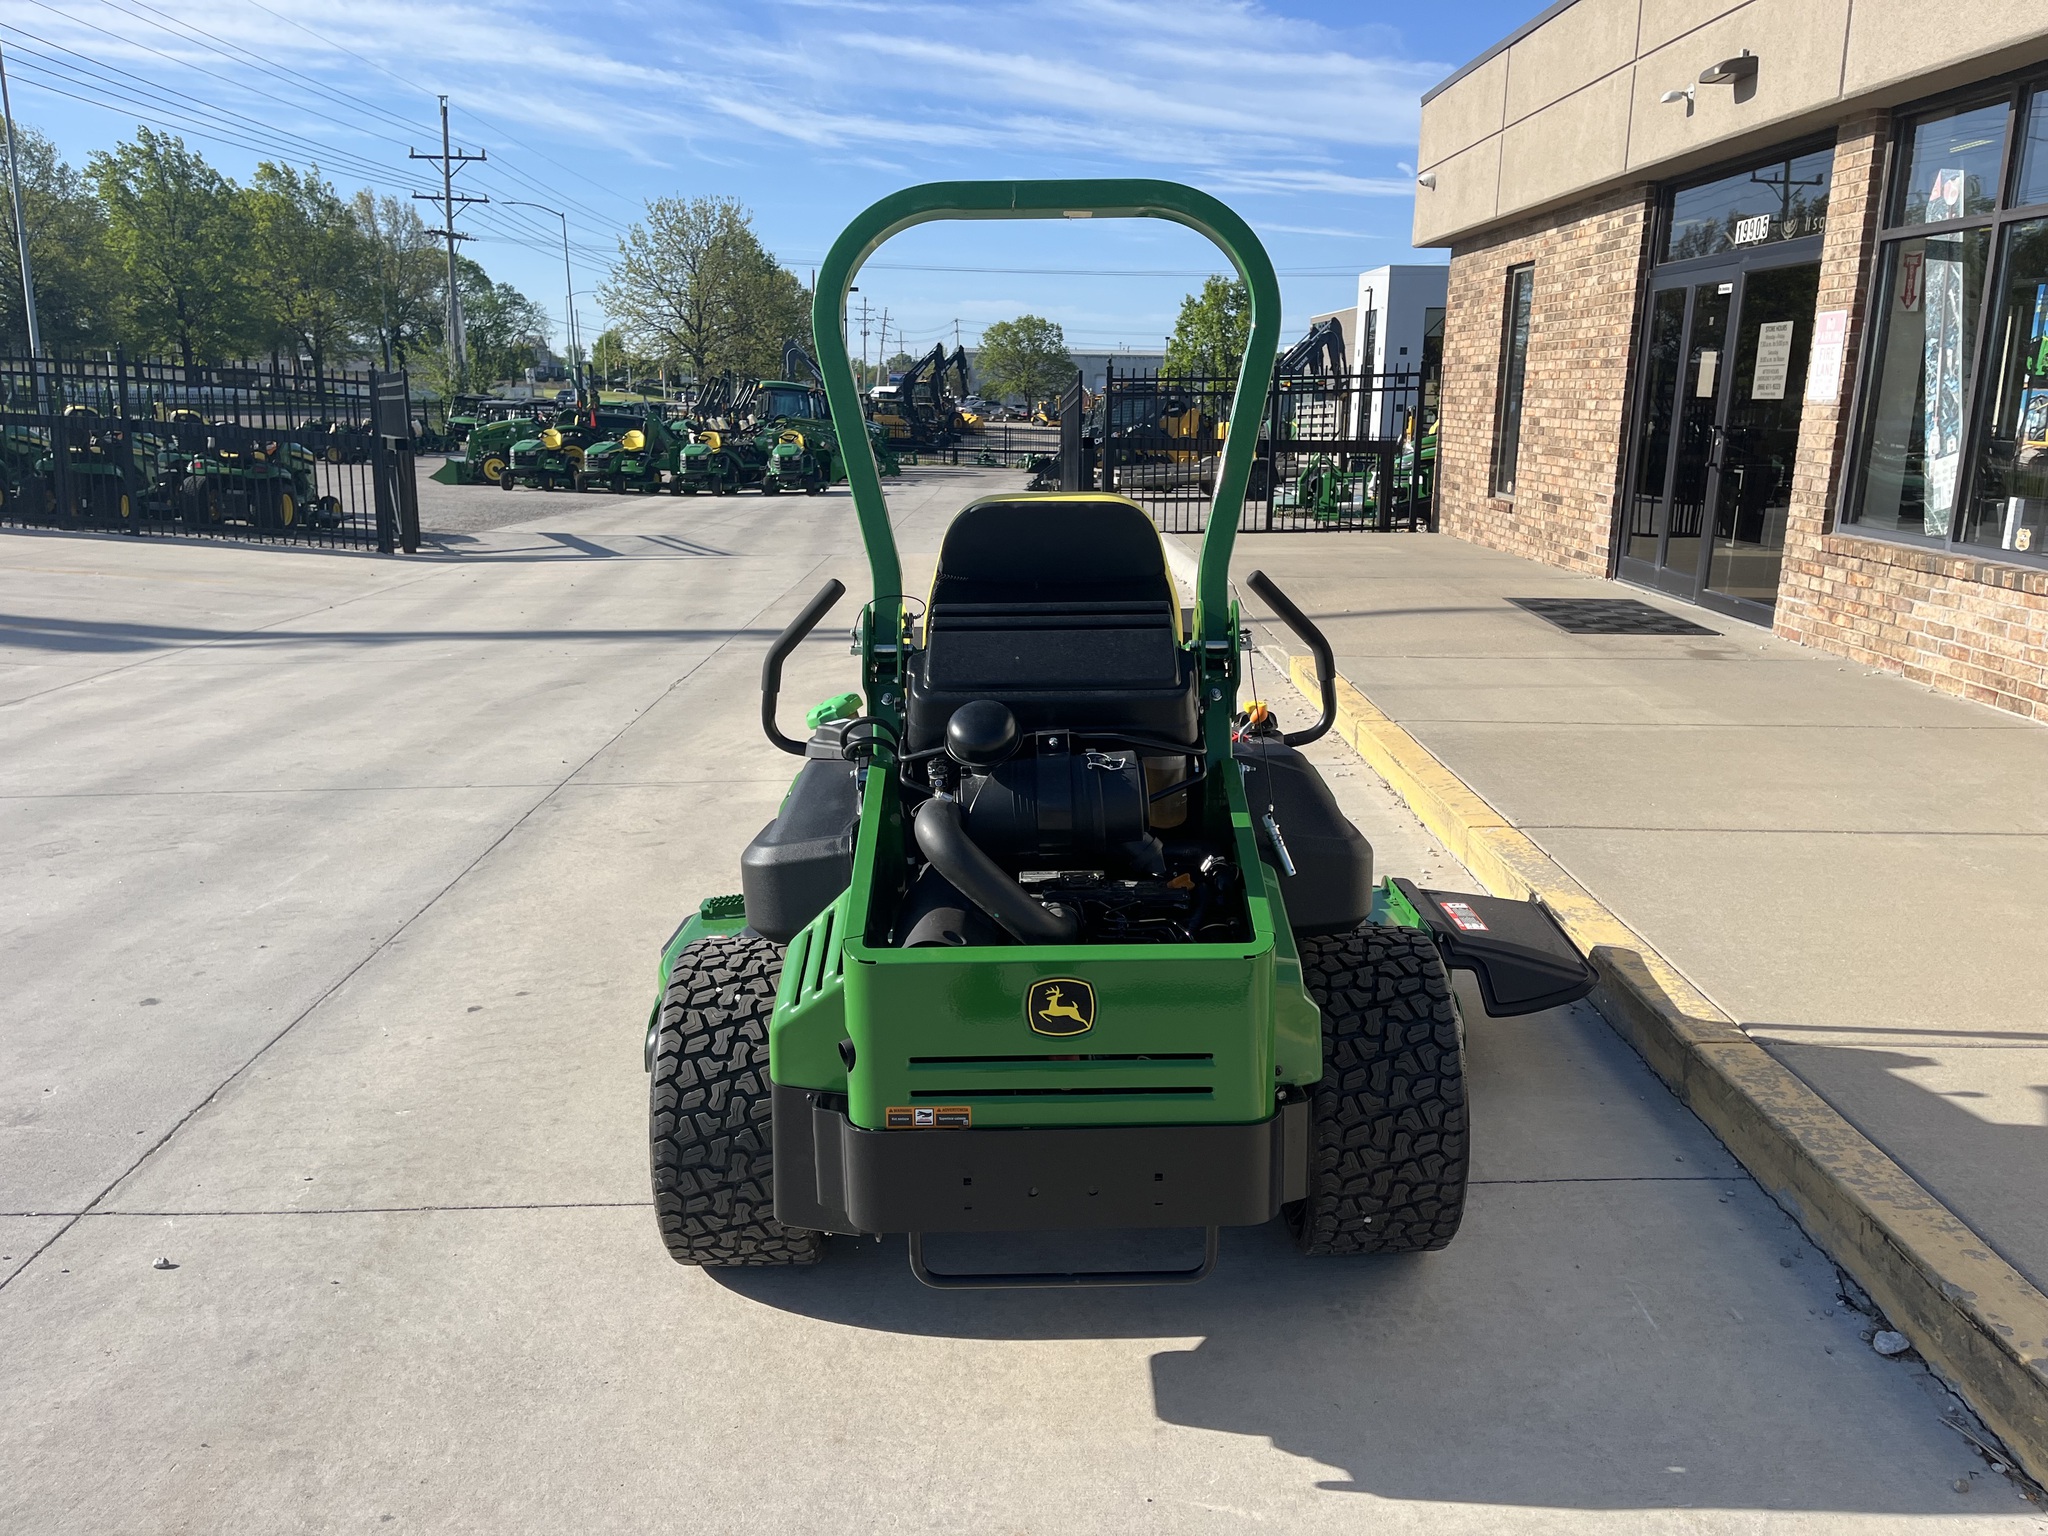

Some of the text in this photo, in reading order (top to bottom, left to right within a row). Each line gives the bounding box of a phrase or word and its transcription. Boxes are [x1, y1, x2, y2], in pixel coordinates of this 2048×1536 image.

[1737, 216, 1768, 242] 19905
[1819, 347, 1835, 361] FIRE
[1816, 363, 1835, 377] LANE
